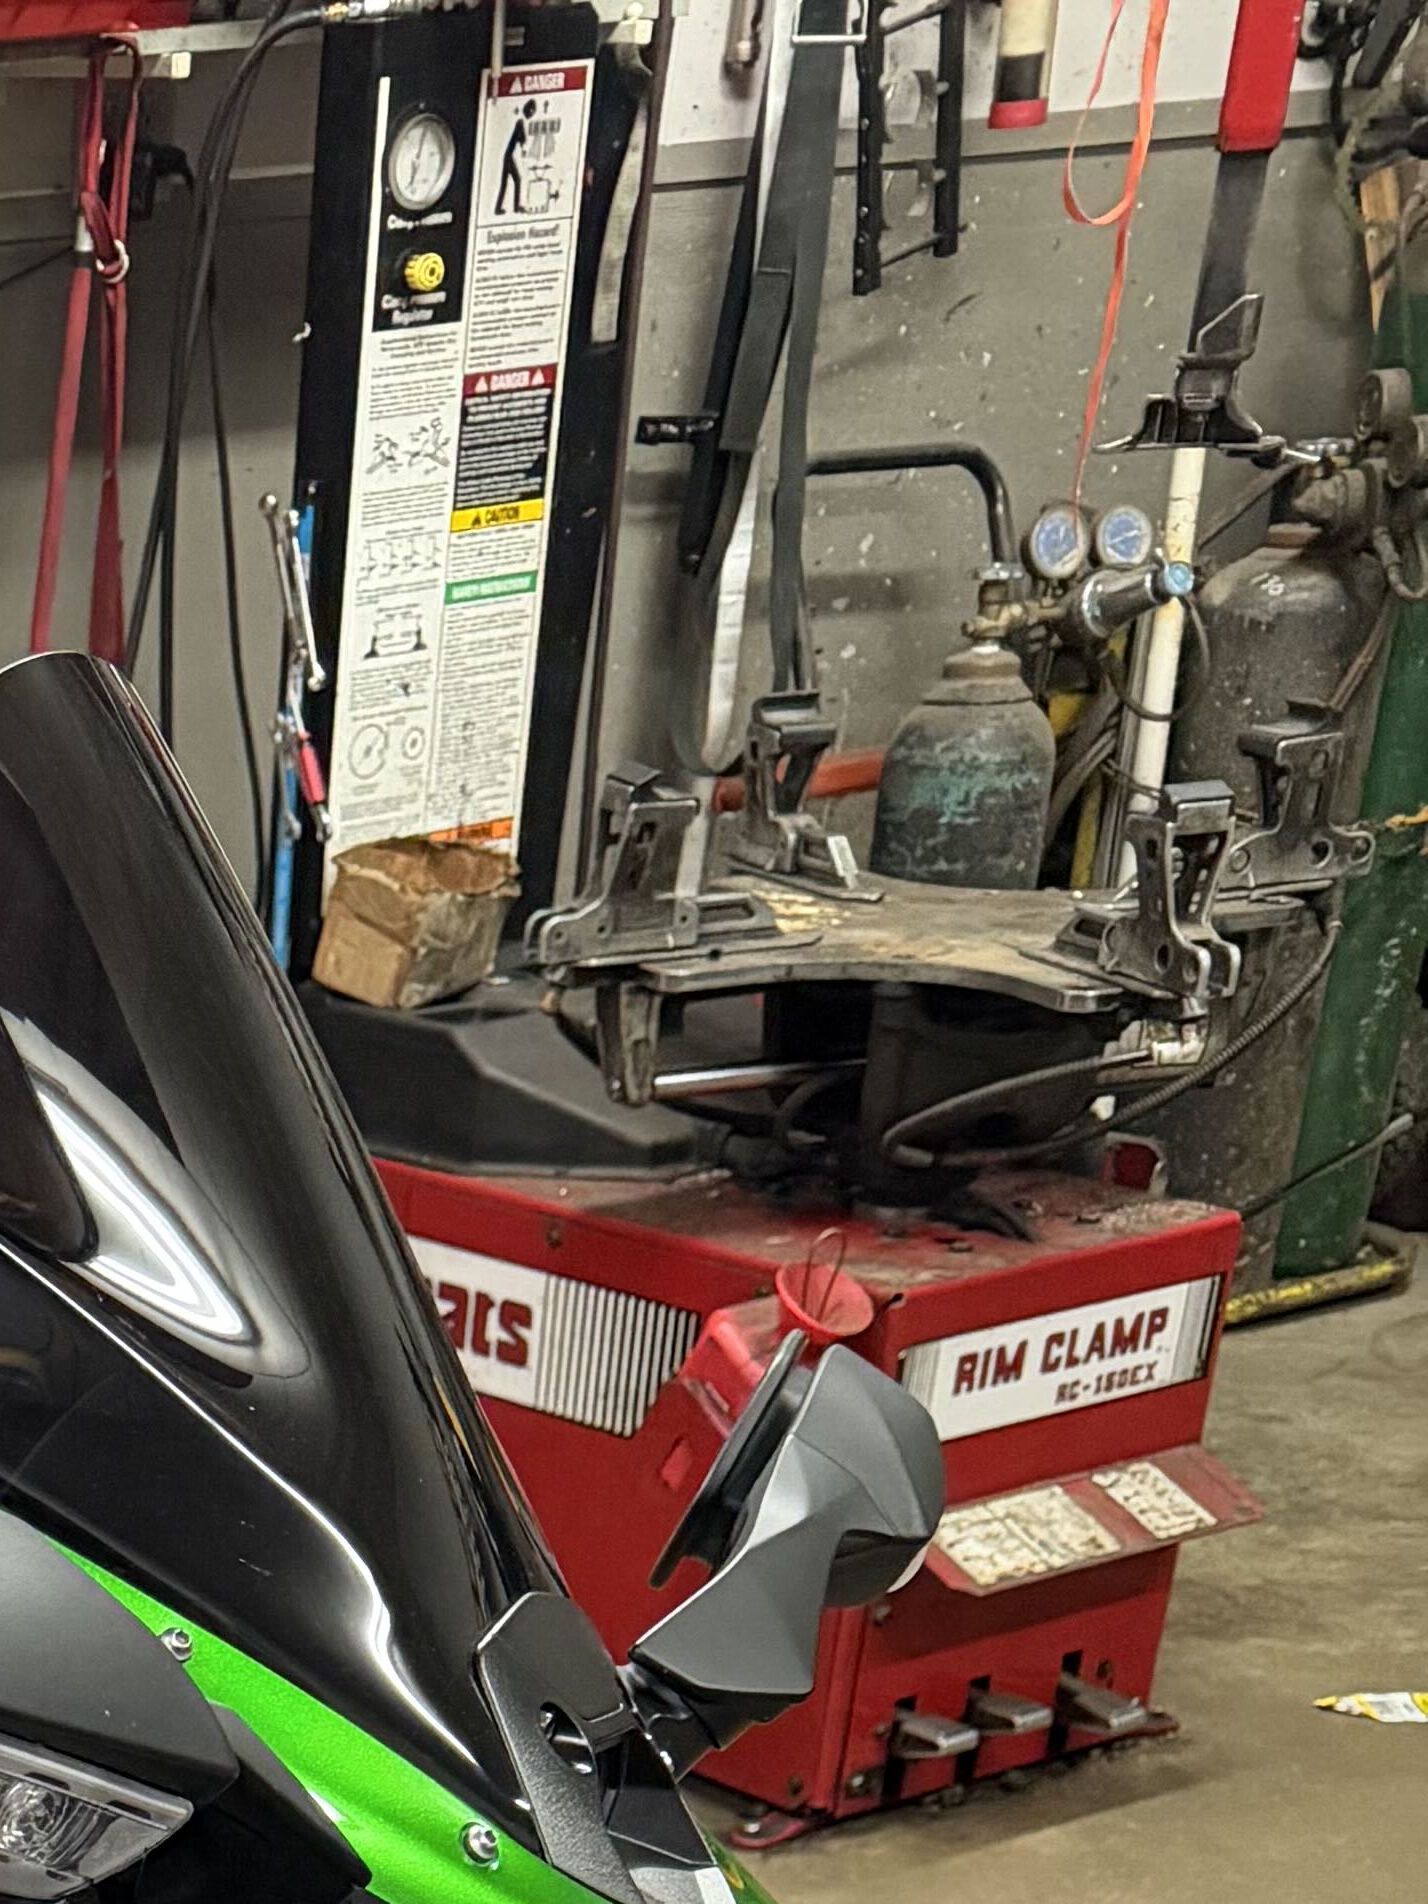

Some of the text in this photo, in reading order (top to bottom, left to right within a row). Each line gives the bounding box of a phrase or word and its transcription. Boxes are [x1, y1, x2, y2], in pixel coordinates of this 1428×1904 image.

[523, 72, 565, 92] DANGER
[485, 506, 520, 524] CAUTION
[952, 1307, 1169, 1396] RIM CLAMP
